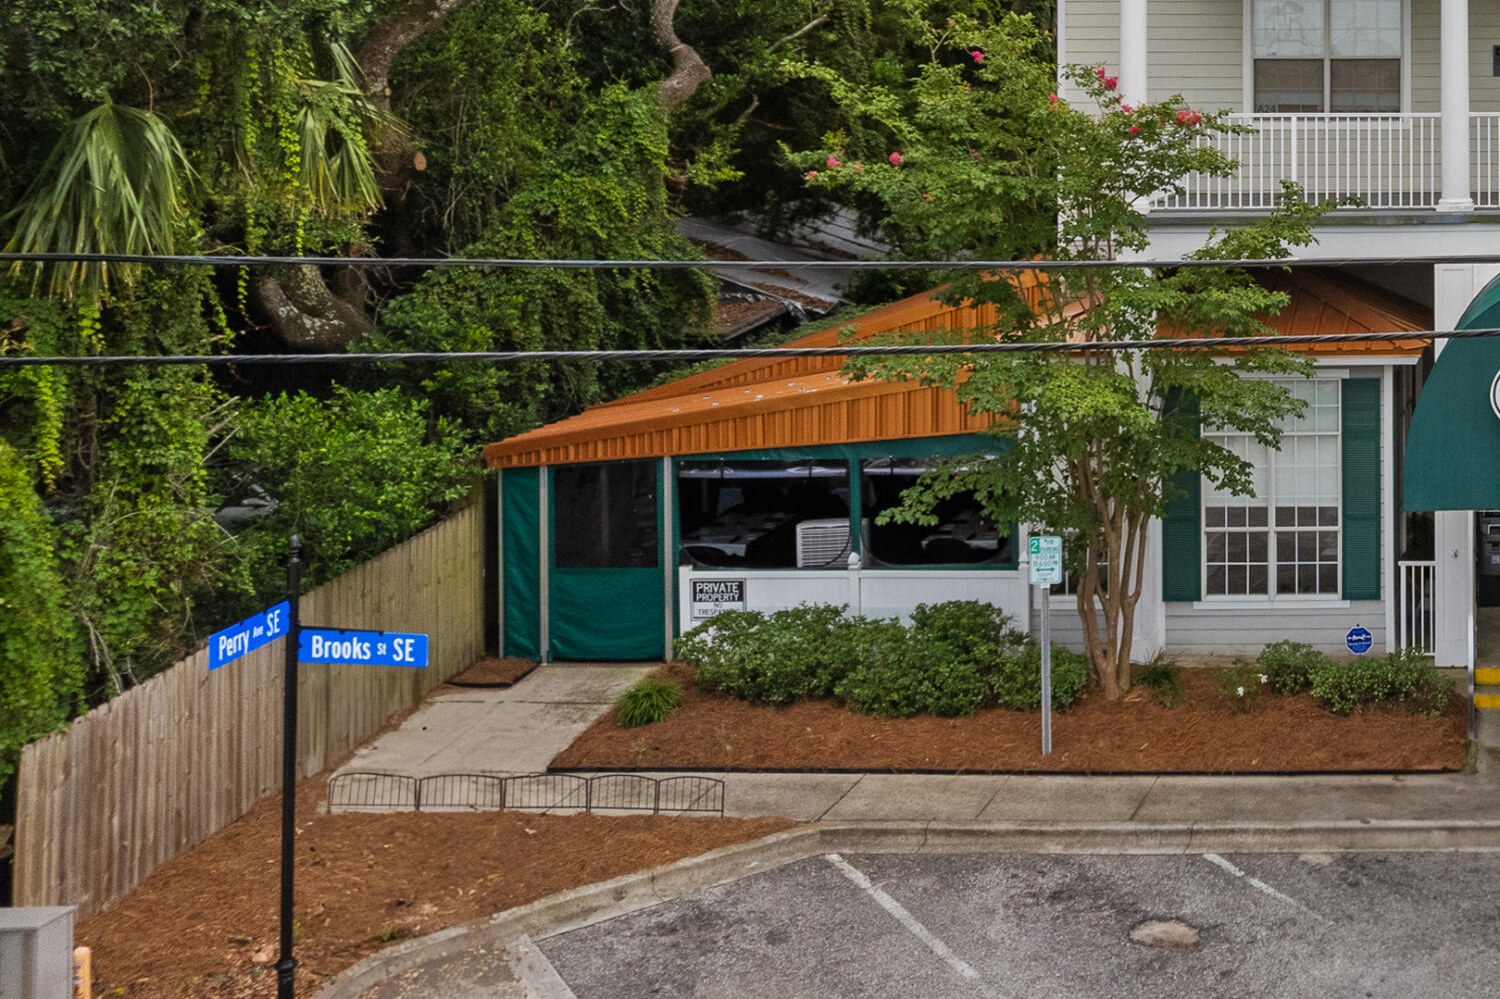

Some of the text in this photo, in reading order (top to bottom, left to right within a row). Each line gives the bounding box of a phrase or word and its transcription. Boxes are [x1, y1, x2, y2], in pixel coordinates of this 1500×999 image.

[1031, 540, 1039, 551] 2
[696, 583, 739, 593] PRIVATE
[696, 592, 740, 602] PROPERTY
[218, 609, 281, 661] Perry Ave SE
[311, 635, 415, 662] Brooks St SE
